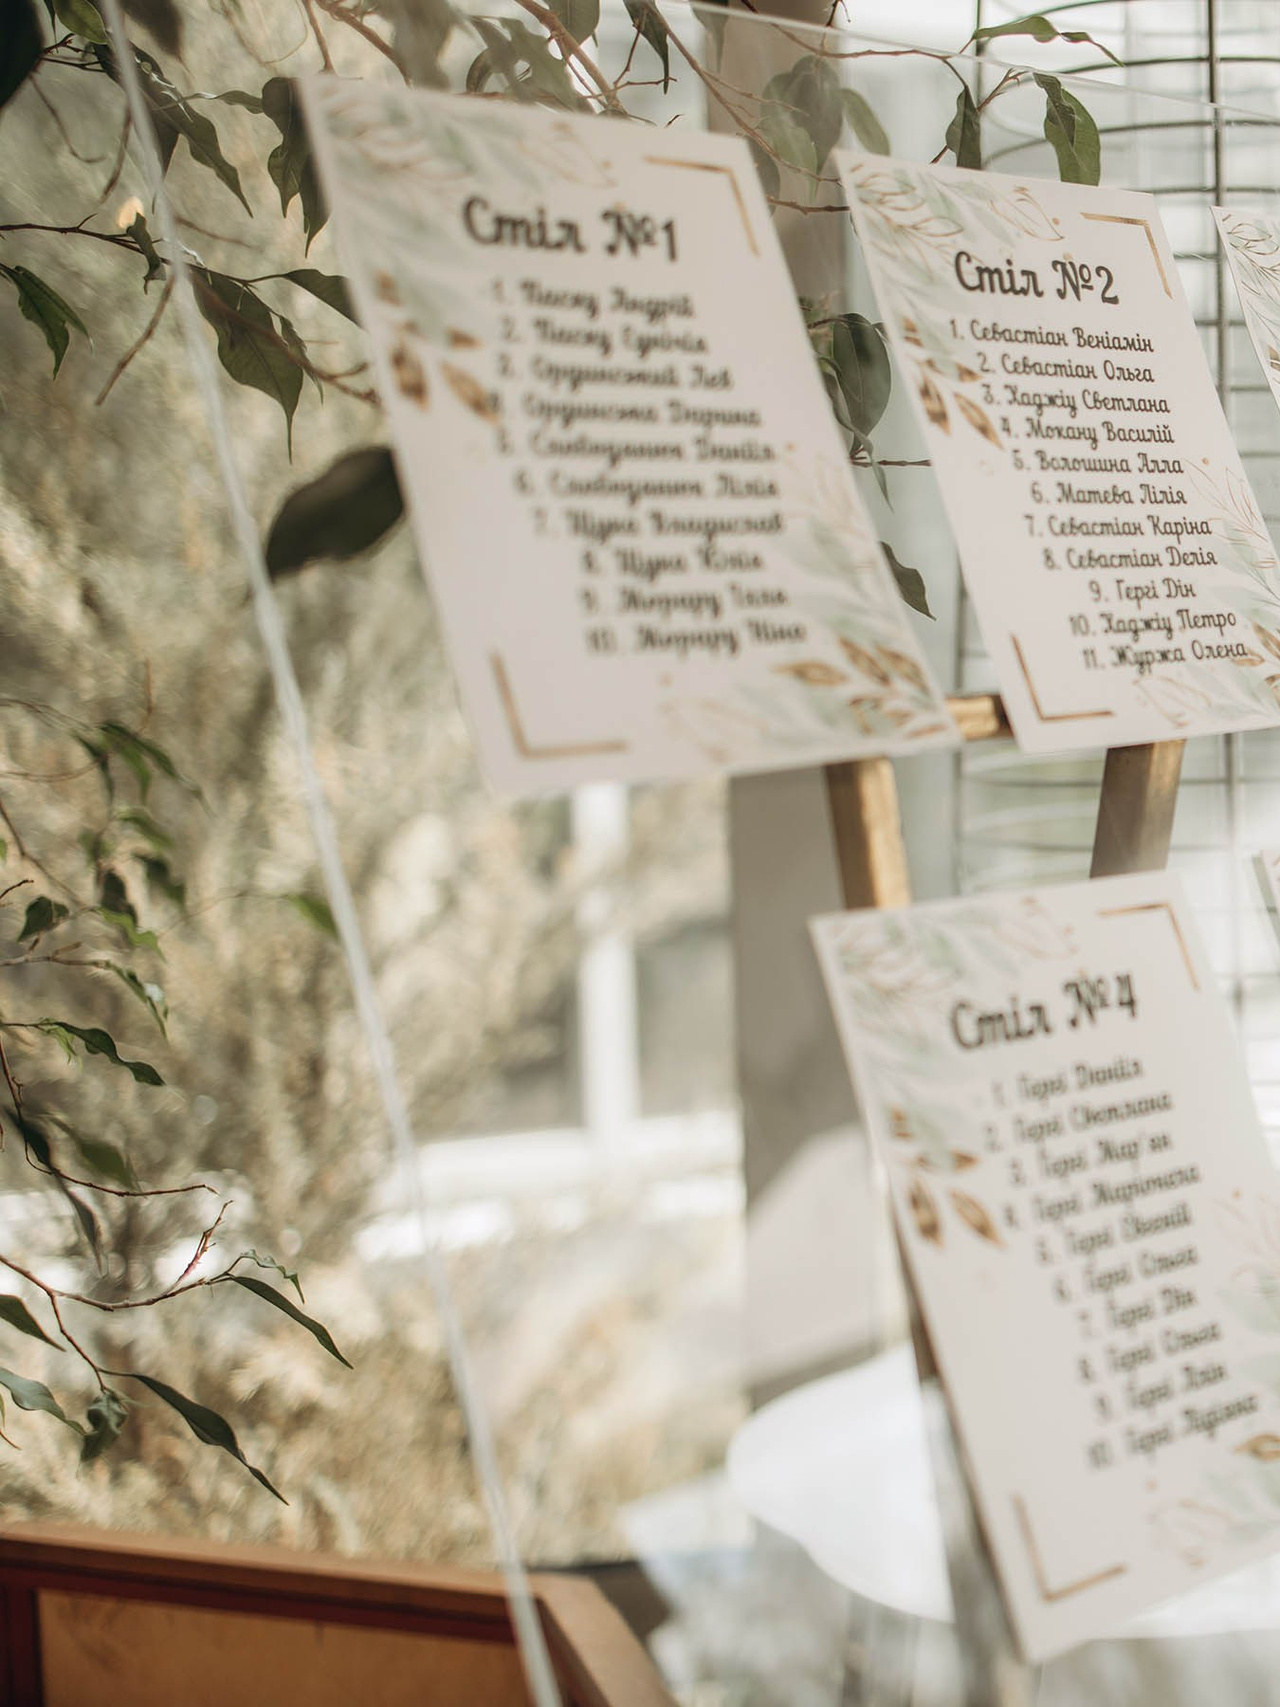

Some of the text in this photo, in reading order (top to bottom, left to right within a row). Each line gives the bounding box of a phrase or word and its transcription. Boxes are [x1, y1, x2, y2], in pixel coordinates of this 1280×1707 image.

[463, 194, 679, 263] Стіл №1
[955, 251, 1119, 305] Стіл №2
[950, 319, 965, 340] 1.
[970, 319, 1068, 347] Севастіан
[977, 352, 1155, 383] 2. Севастіан Ольга
[981, 384, 1000, 404] 3.
[1004, 385, 1078, 418] Хаджіу
[1001, 417, 1175, 449] 4. Мокану Василій
[1012, 450, 1031, 471] 5.
[1137, 453, 1184, 474] Алла
[1031, 482, 1049, 503] 6.
[1140, 483, 1187, 505] Лілія
[1024, 515, 1213, 544] 7. Севастіан Каріна
[1043, 549, 1061, 569] 8.
[1066, 548, 1163, 569] Севастіан
[1089, 577, 1197, 610] 9. Гергі Дін
[1070, 608, 1237, 642] 10. Хаджіу Петро
[1084, 648, 1105, 669] 11.
[951, 973, 1138, 1051] Стіл №4
